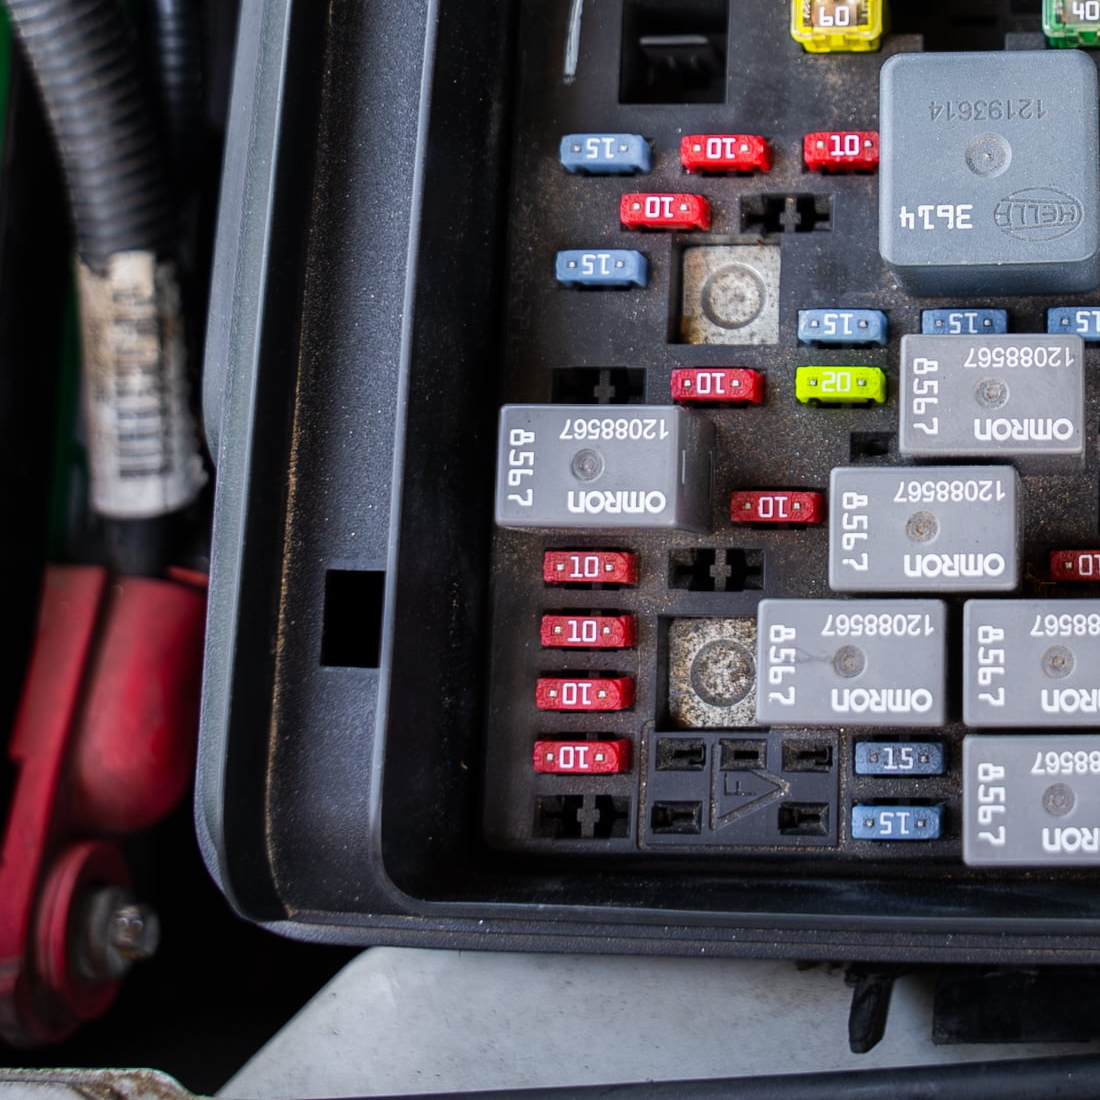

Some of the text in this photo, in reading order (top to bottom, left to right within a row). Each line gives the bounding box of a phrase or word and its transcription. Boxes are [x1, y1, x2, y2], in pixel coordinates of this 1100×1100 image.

[819, 5, 850, 26] 60
[1072, 0, 1100, 21] 40
[928, 99, 1047, 121] 12193614
[586, 137, 615, 159] 15
[707, 138, 735, 159] 10
[831, 135, 859, 156] 10
[645, 196, 674, 218] 10
[900, 204, 973, 230] 3614
[582, 253, 610, 275] 15
[823, 313, 854, 335] 15
[949, 312, 978, 334] 15
[963, 347, 1075, 368] 12088567
[697, 372, 725, 394] 10
[822, 371, 850, 392] 20
[913, 357, 939, 435] 8567
[559, 419, 670, 440] 12088567
[507, 429, 535, 507] 8567
[893, 480, 1006, 502] 12088567
[760, 496, 787, 518] 10
[842, 491, 868, 571] 8567
[570, 556, 599, 577] 10
[568, 620, 597, 642] 10
[821, 614, 935, 636] 12088567
[768, 624, 796, 705] 8567
[978, 625, 1005, 707] 8567
[563, 683, 591, 705] 10
[559, 746, 589, 768] 10
[884, 747, 914, 770] 15
[978, 763, 1006, 846] 8567
[880, 812, 910, 834] 15
